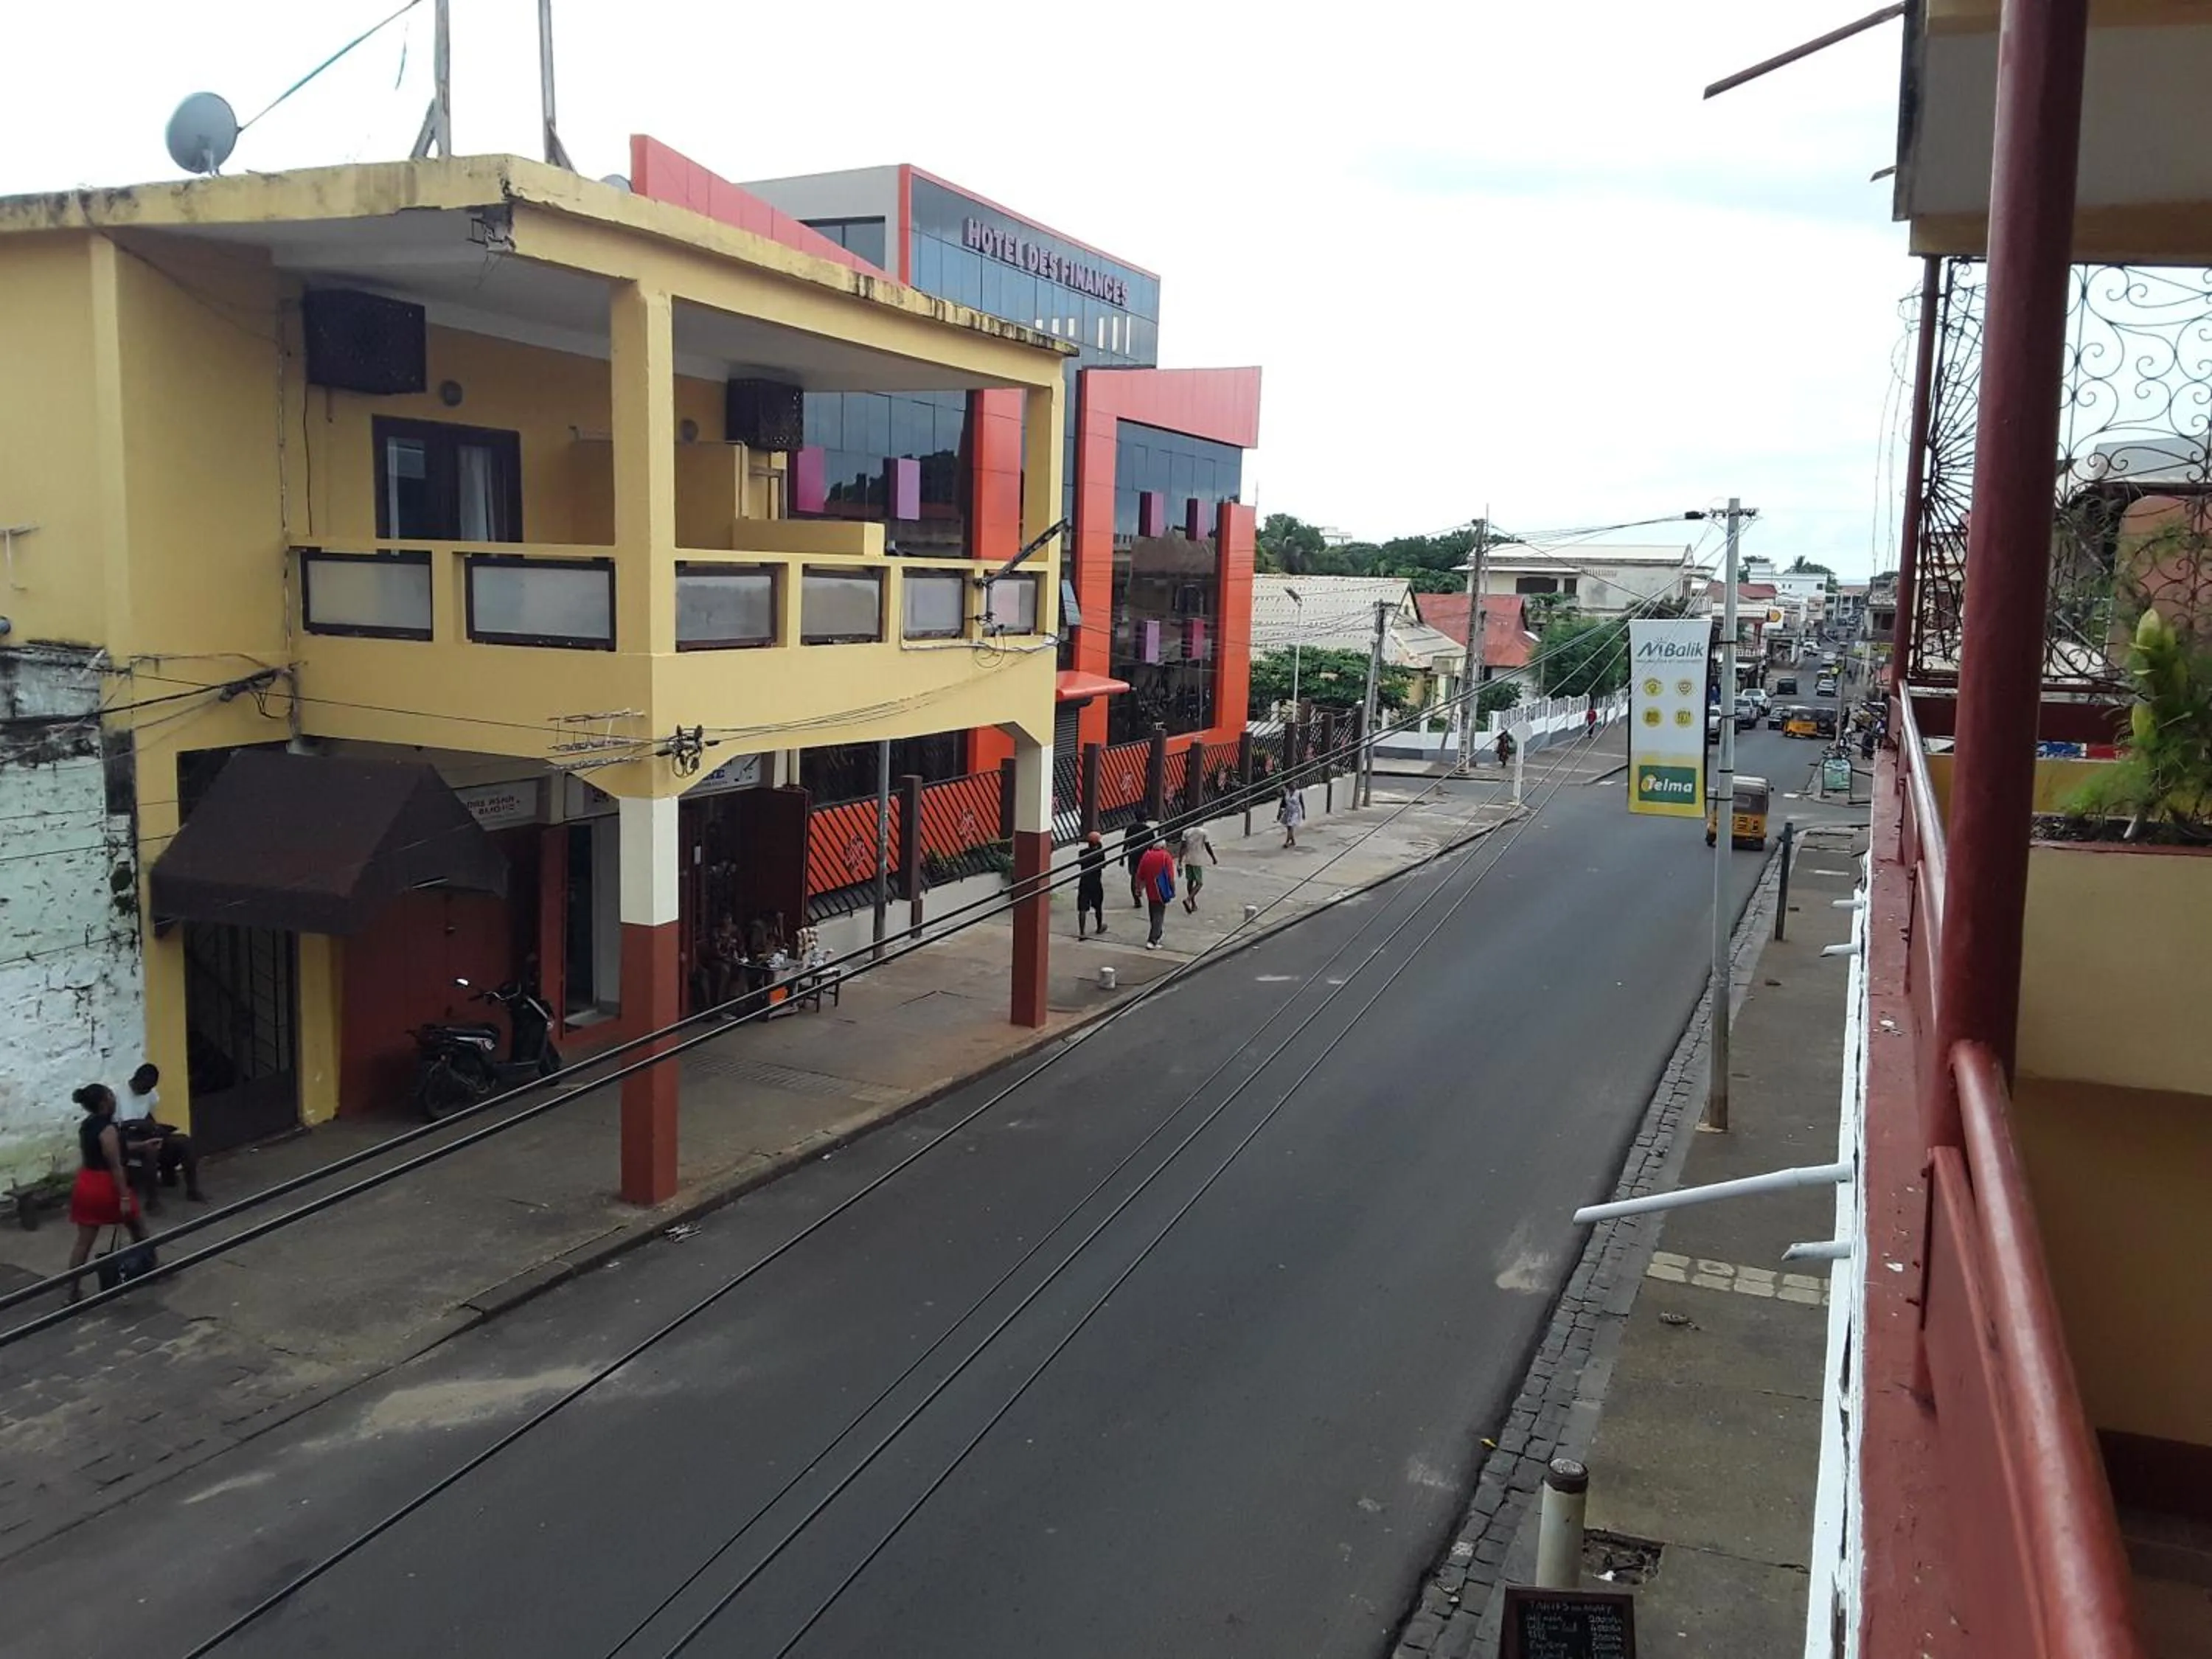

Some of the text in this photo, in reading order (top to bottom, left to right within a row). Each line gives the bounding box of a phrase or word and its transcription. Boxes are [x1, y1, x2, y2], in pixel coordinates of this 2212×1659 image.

[965, 217, 1130, 308] HOTEL DES FINANCES
[1645, 777, 1694, 794] Telma
